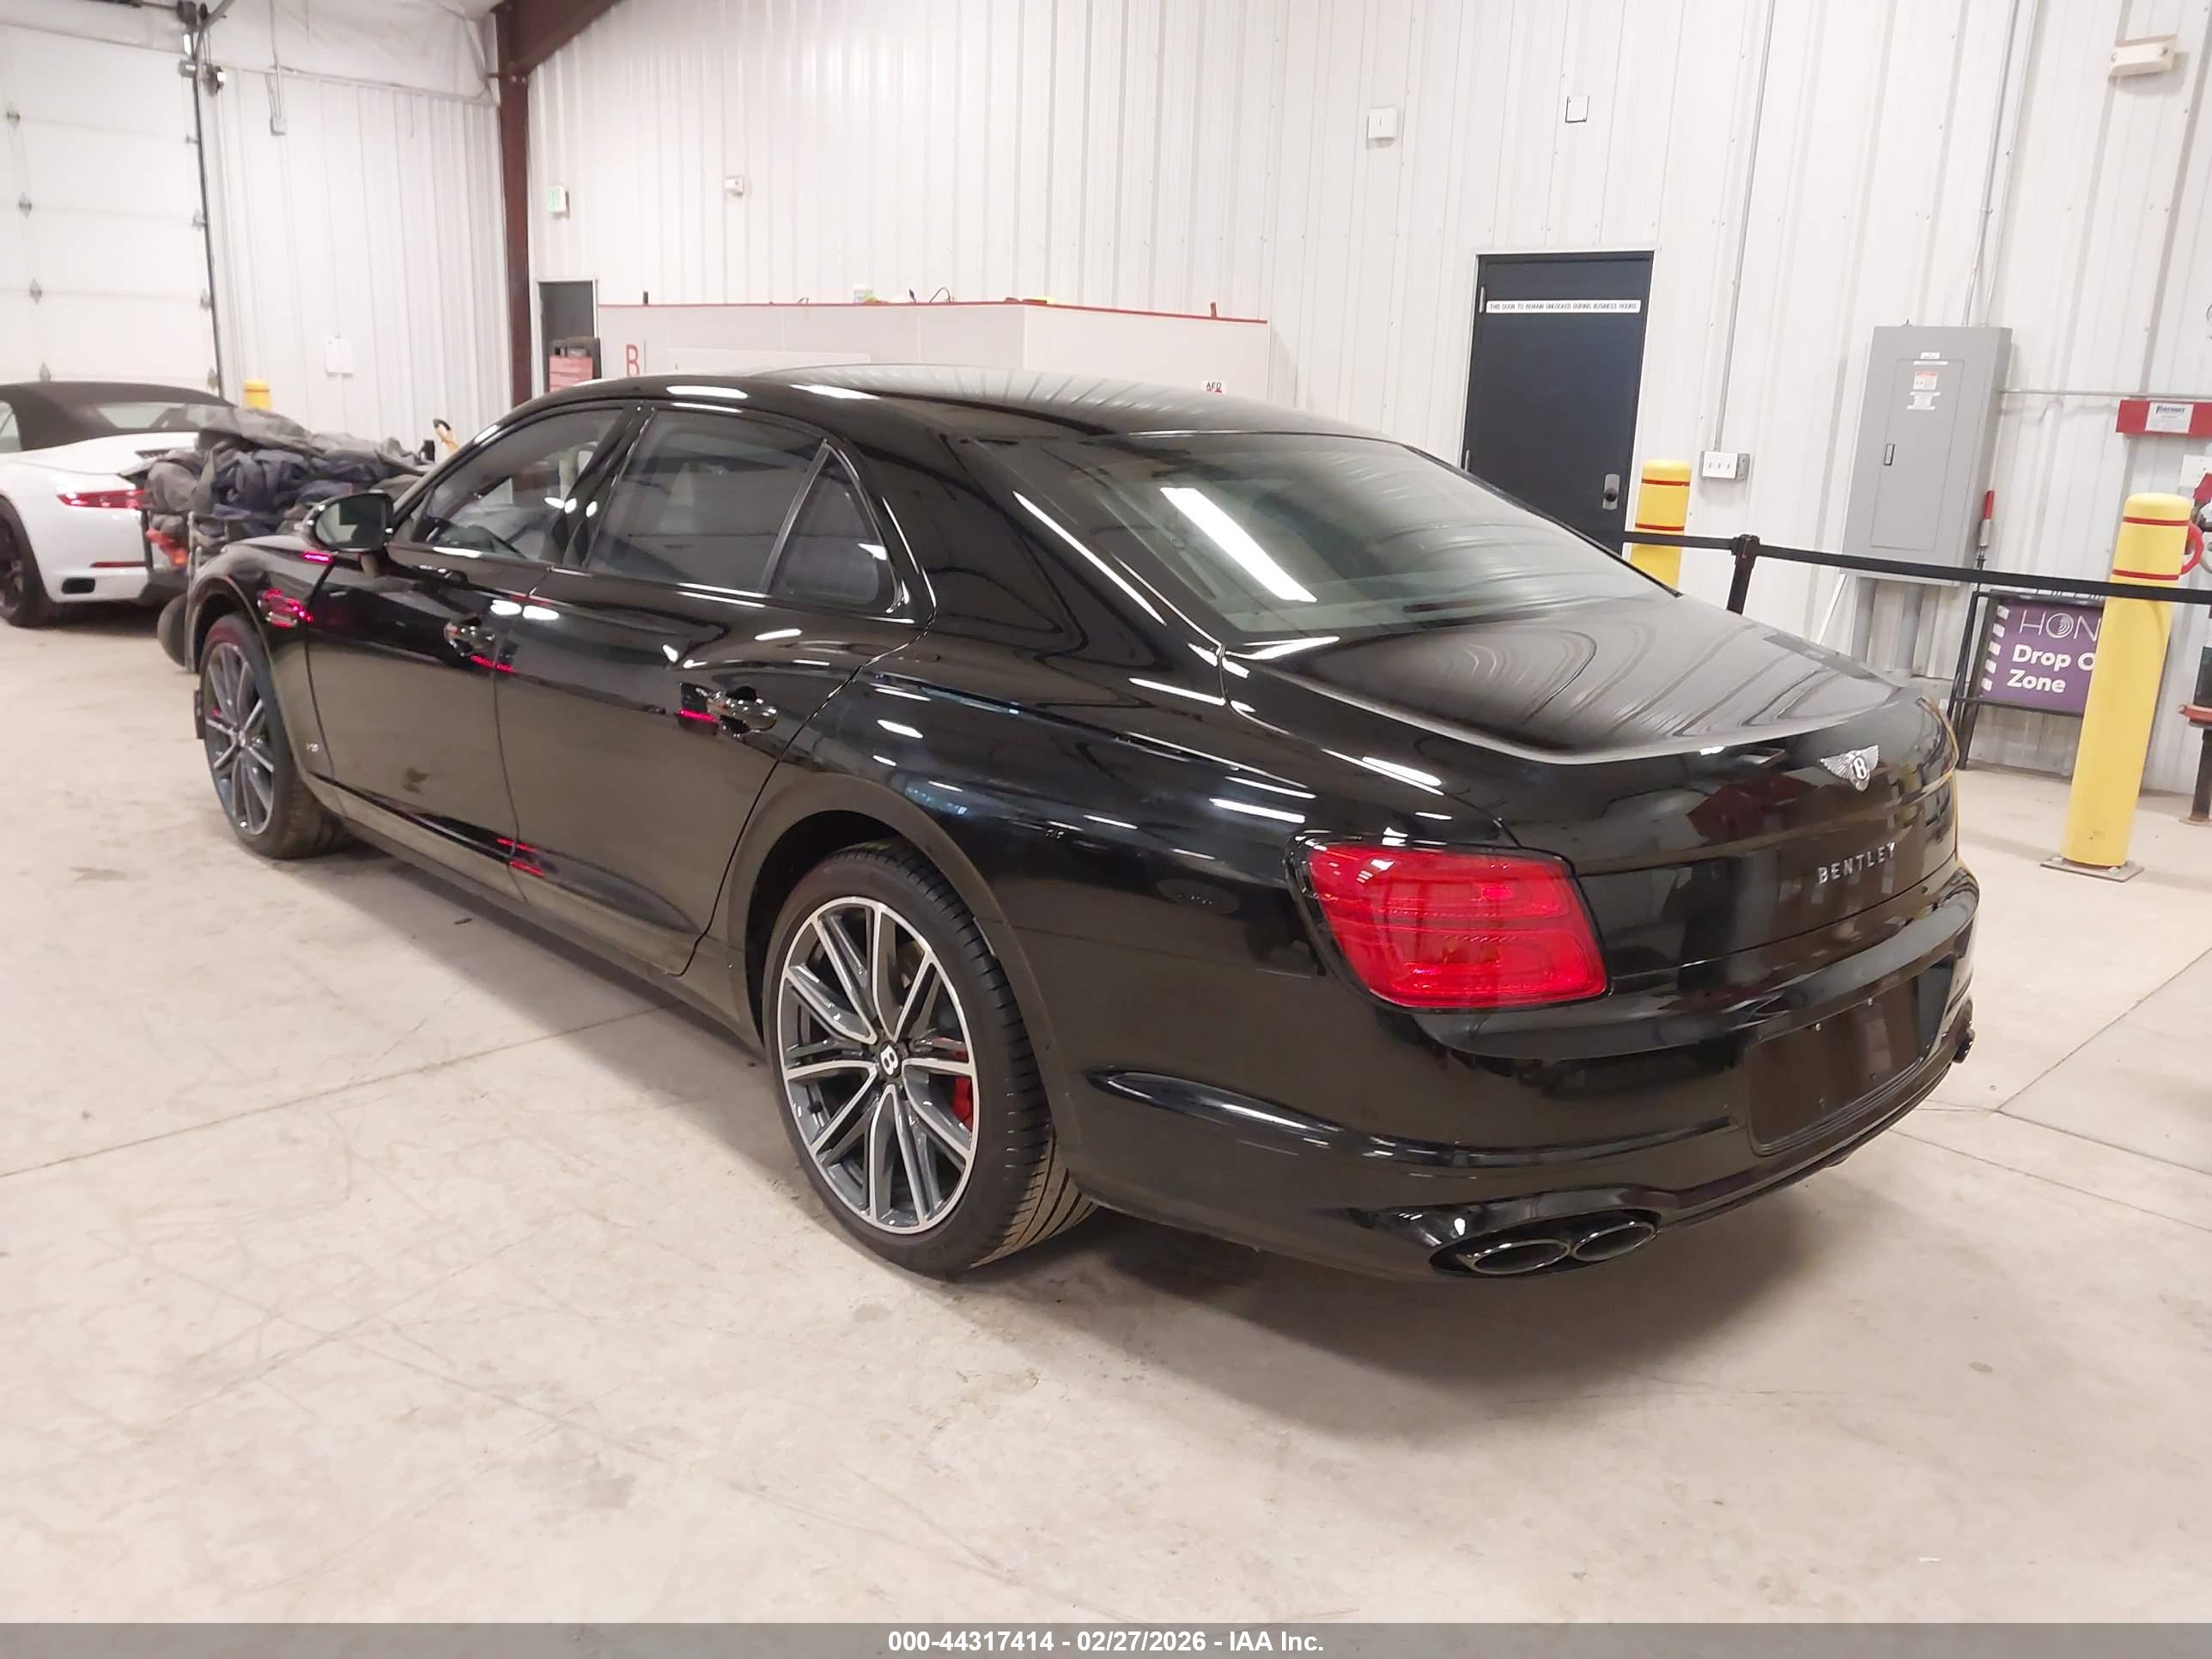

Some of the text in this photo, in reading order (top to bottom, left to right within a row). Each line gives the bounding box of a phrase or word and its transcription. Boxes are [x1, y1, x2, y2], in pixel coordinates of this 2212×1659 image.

[2012, 643, 2072, 672] Drop
[2007, 668, 2067, 694] Zone
[1817, 841, 1896, 884] BENTLEY
